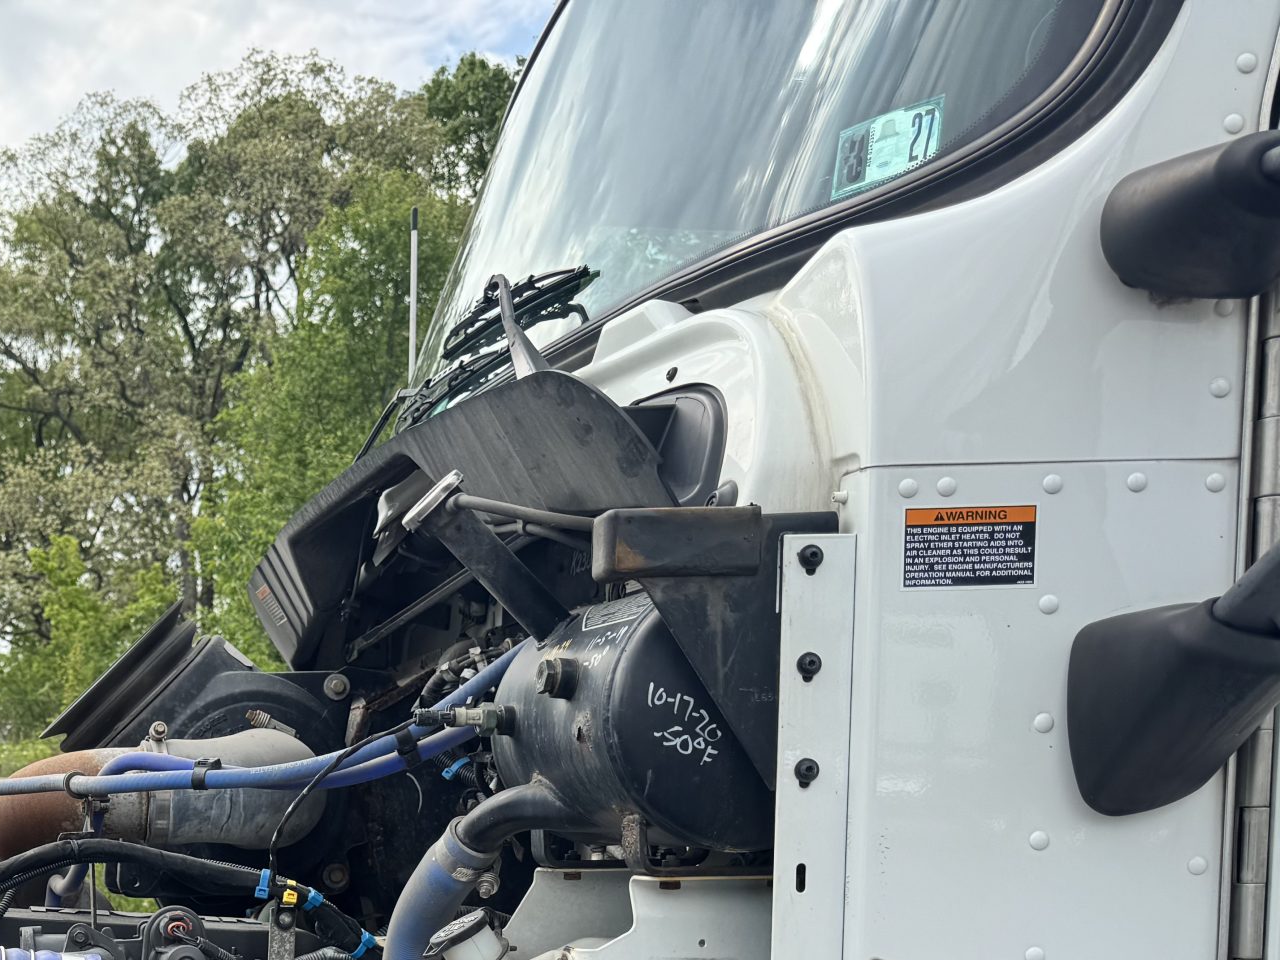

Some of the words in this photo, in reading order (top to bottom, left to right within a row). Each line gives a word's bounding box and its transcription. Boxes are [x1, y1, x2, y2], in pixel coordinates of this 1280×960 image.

[908, 108, 936, 163] 27
[946, 510, 1007, 520] WARNING
[647, 682, 722, 742] 10-17-20
